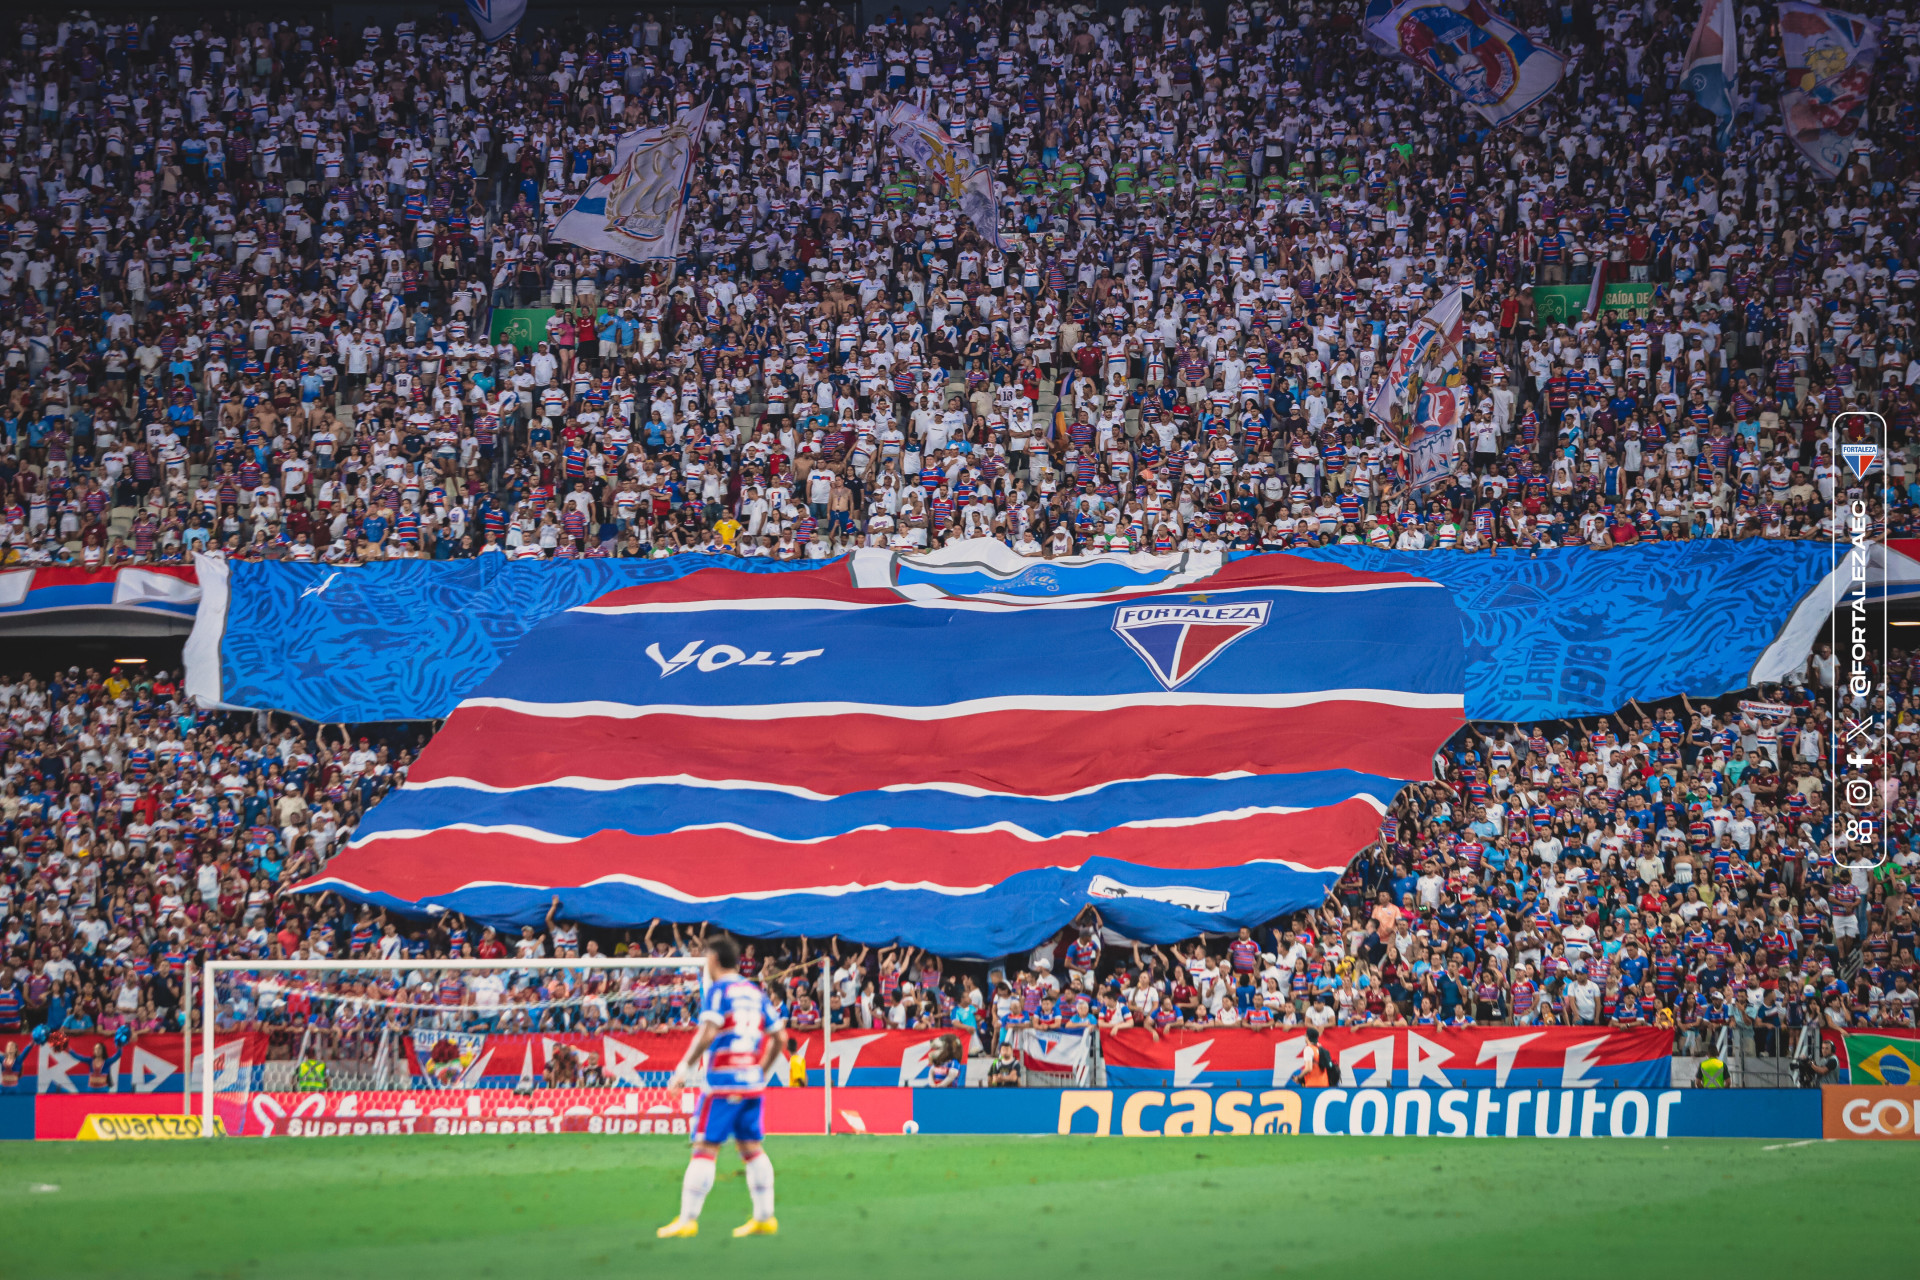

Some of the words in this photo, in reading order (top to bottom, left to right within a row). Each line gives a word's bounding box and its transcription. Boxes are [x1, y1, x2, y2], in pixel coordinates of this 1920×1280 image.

[904, 247, 913, 255] 18
[1605, 290, 1634, 305] SAÍDA
[1636, 292, 1649, 304] DE
[1123, 607, 1261, 624] FORTALEZA
[645, 640, 825, 679] VOLT
[1522, 637, 1561, 702] LAION
[1557, 644, 1612, 708] 1918
[411, 1032, 481, 1048] ORTAEZA
[1271, 1030, 1611, 1088] FORTE
[1121, 1089, 1302, 1136] casa
[1264, 1116, 1292, 1135] do
[1312, 1088, 1682, 1138] construtor
[98, 1116, 225, 1139] quartzolt
[286, 1117, 417, 1137] SUPERBET
[433, 1116, 562, 1136] SUPERBET
[589, 1115, 697, 1135] SUPERB
